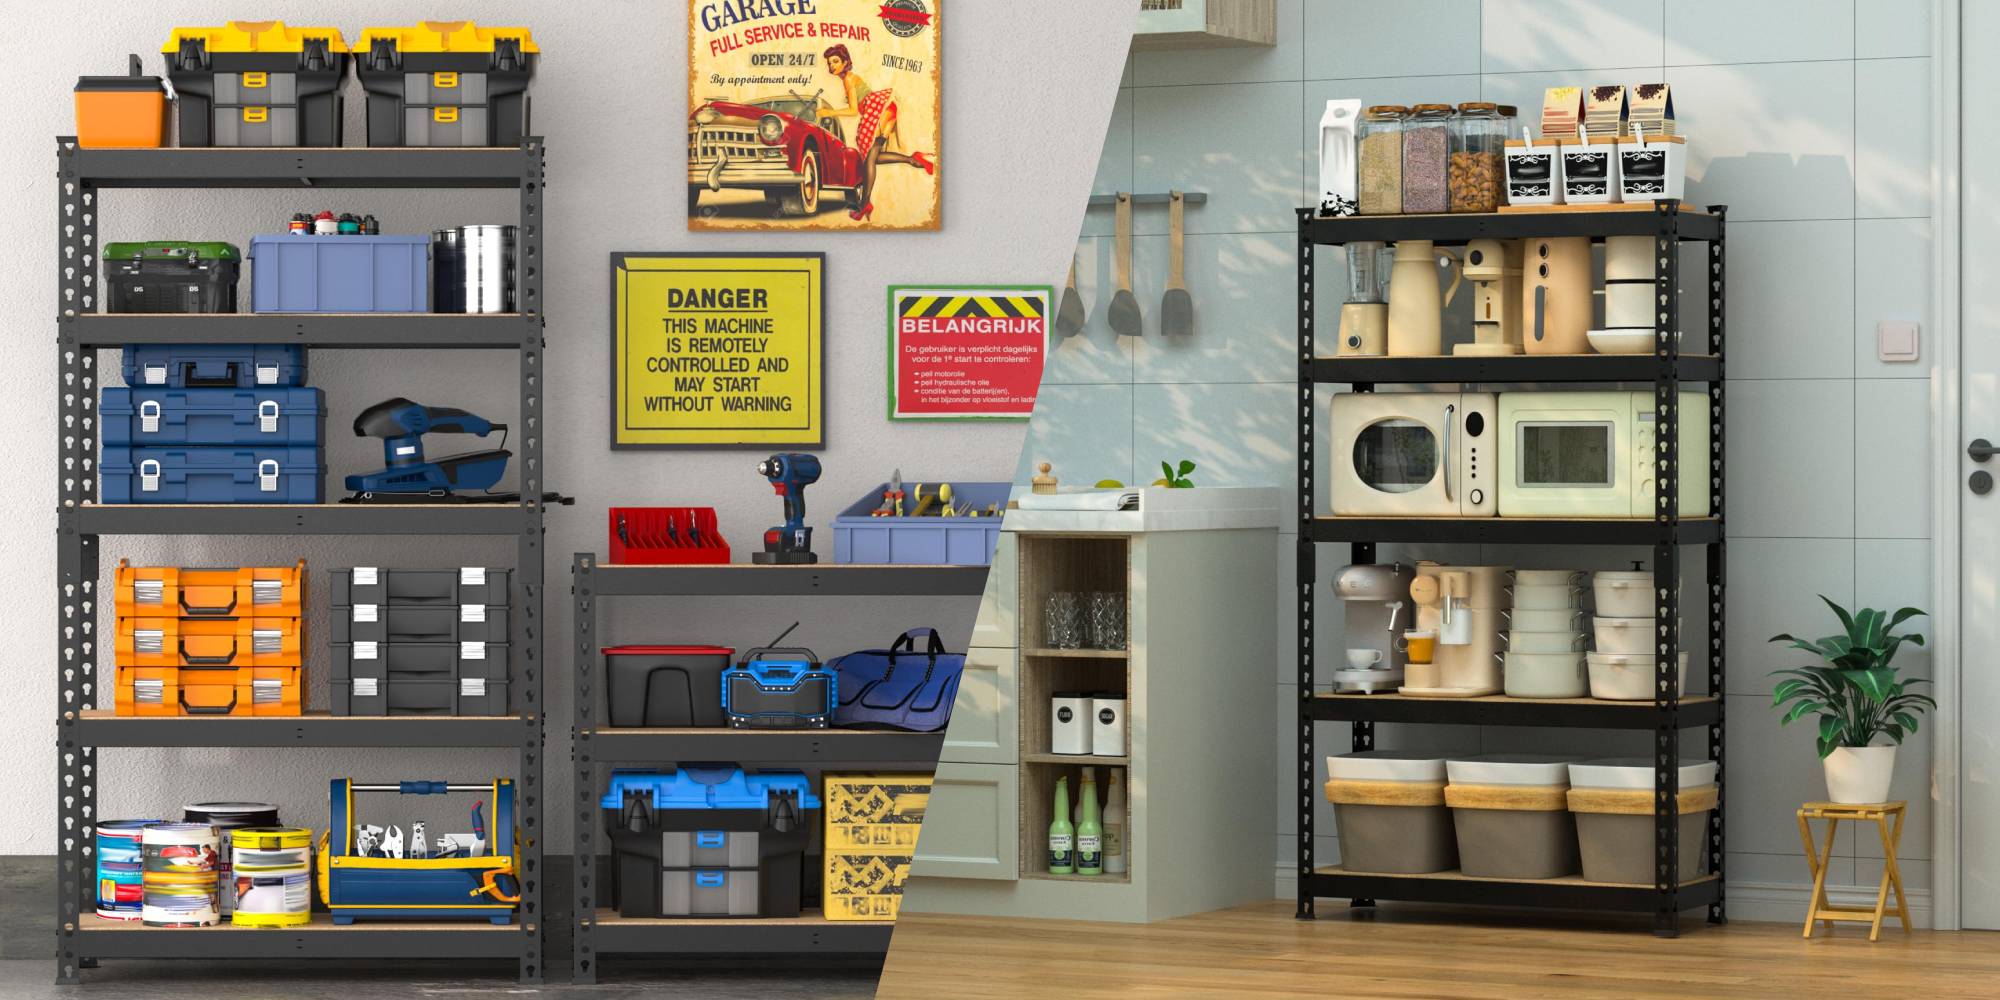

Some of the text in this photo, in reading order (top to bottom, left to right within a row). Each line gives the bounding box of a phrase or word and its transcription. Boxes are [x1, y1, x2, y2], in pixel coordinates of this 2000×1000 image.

[709, 22, 871, 57] FULL SERVICE & REPAIR
[751, 53, 816, 66] OPEN 24/7
[882, 53, 923, 73] SINCE 1963
[710, 73, 813, 87] By appointment only!
[667, 288, 768, 309] DANGER
[662, 318, 774, 334] THIS MACHINE
[902, 318, 1042, 334] BELANGRIJK
[666, 337, 768, 353] IS REMOTELY
[905, 345, 1038, 355] De gebruiker is verplicht dagelijks
[646, 357, 789, 373] CONTROLLED AND
[931, 355, 943, 363] de
[954, 355, 973, 363] start
[974, 355, 982, 363] te
[983, 355, 1031, 363] controleren:
[674, 376, 761, 392] MAY START
[644, 396, 792, 411] WITHOUT WARNING
